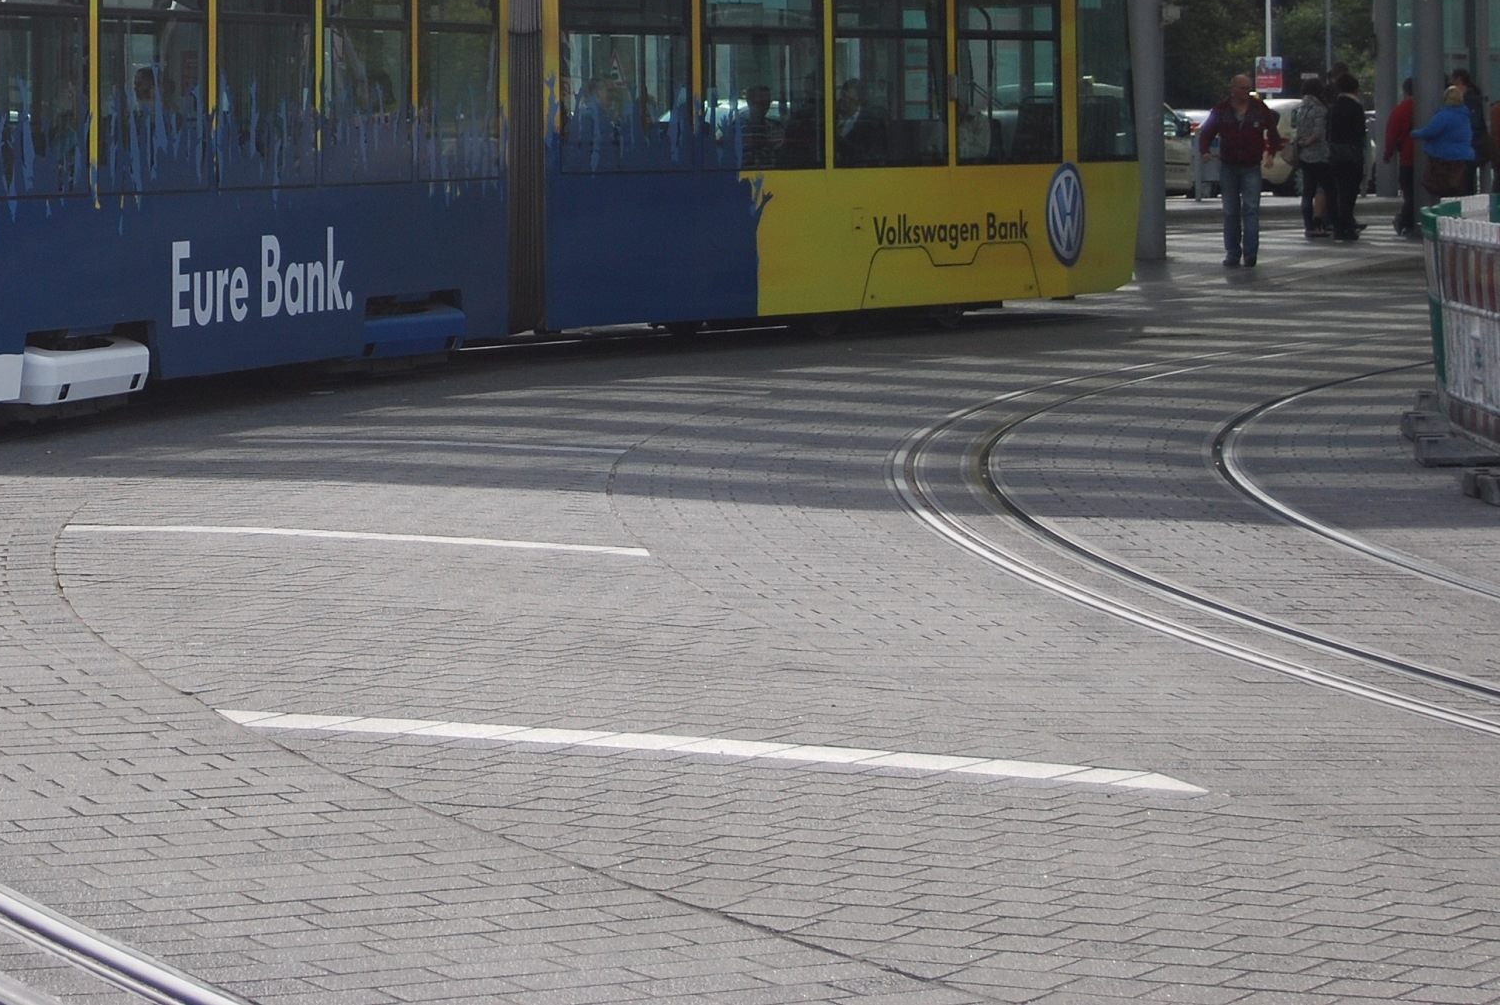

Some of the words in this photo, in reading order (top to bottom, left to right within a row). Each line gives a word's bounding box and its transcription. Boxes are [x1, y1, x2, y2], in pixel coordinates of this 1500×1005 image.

[873, 213, 980, 250] Volkswagen
[986, 209, 1029, 241] Bank
[171, 240, 249, 328] Eure
[261, 225, 353, 318] Bank.
